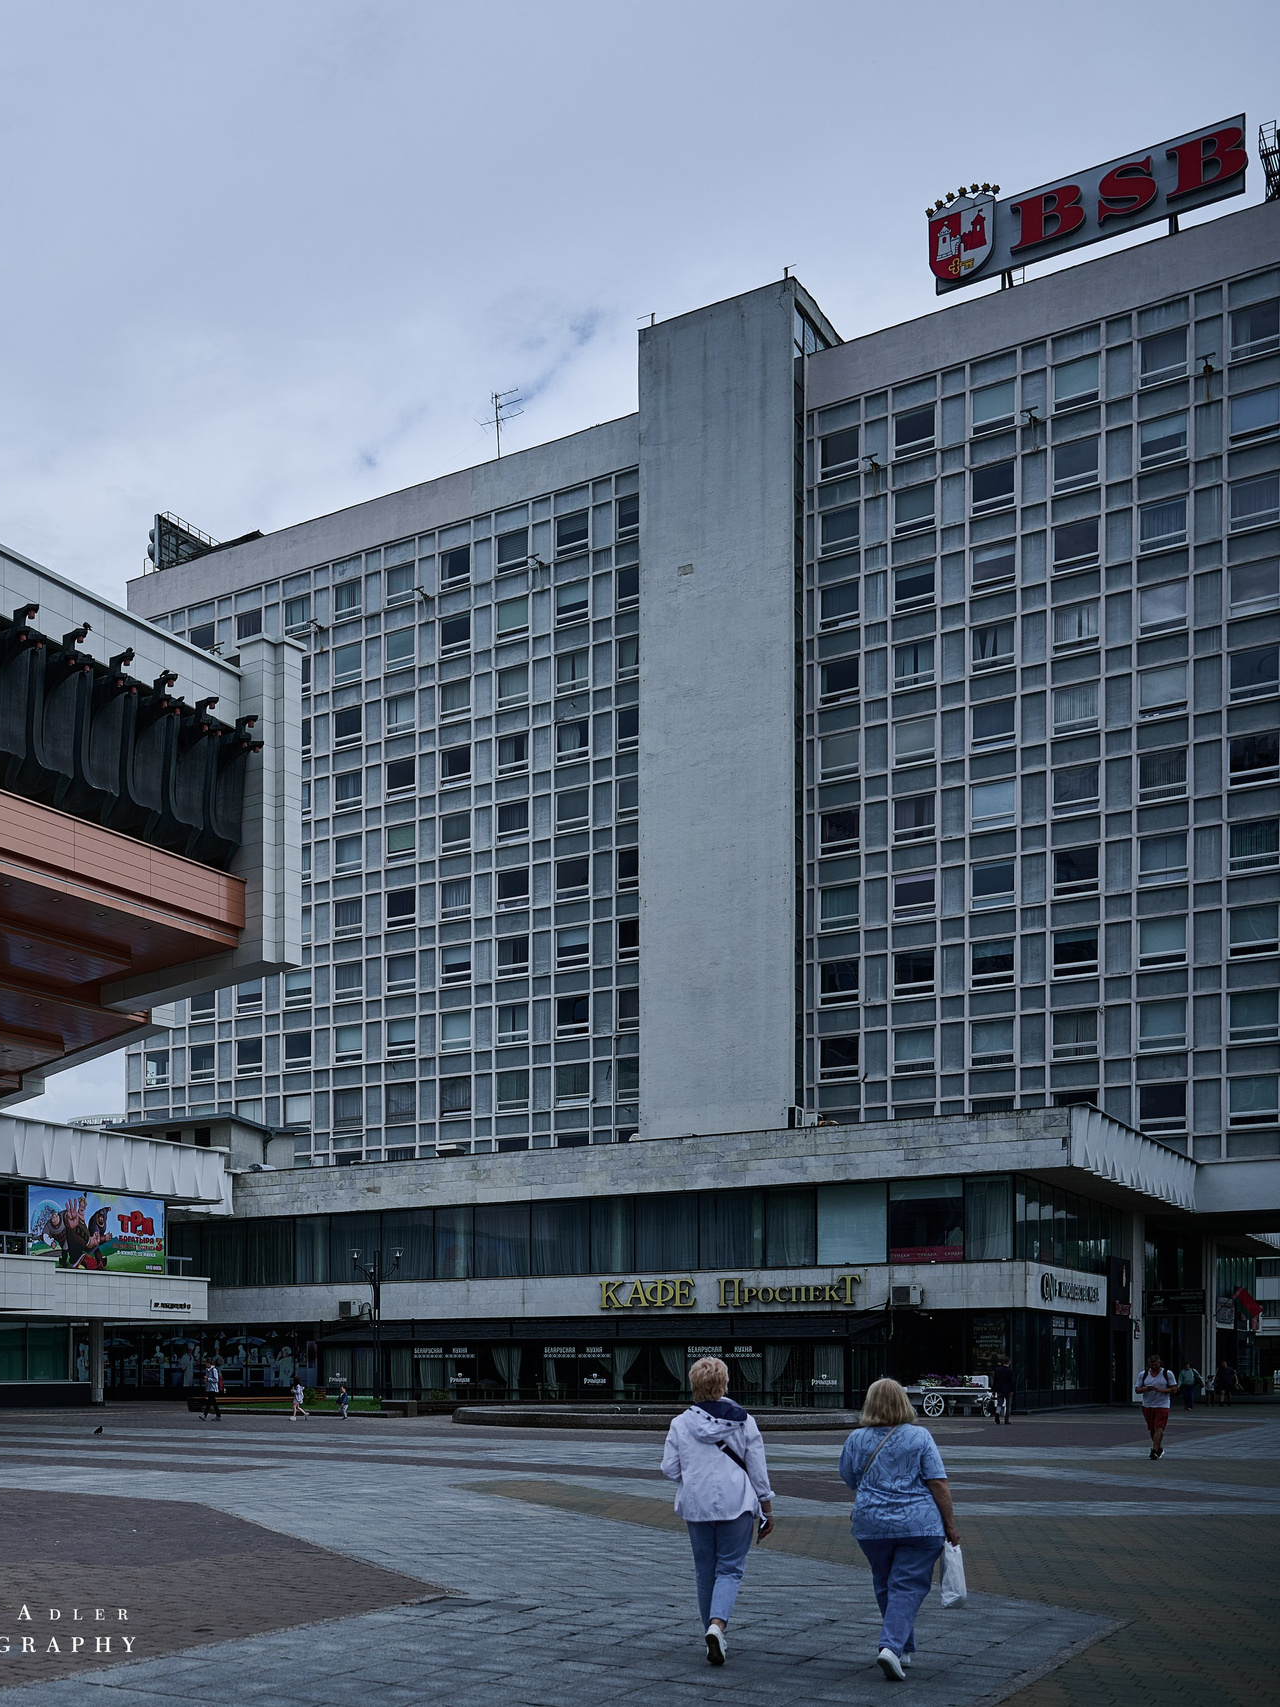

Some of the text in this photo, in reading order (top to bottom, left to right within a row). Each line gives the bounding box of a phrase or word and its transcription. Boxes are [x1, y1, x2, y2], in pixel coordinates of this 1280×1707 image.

[1009, 126, 1249, 256] BSB
[118, 1210, 155, 1236] ТРИ
[119, 1235, 154, 1244] БОГАТЫРЯ
[156, 1238, 162, 1251] 3
[600, 1278, 696, 1308] КАФЕ
[687, 1345, 753, 1353] БЕЛАРУСКАЯ КУХНЯ
